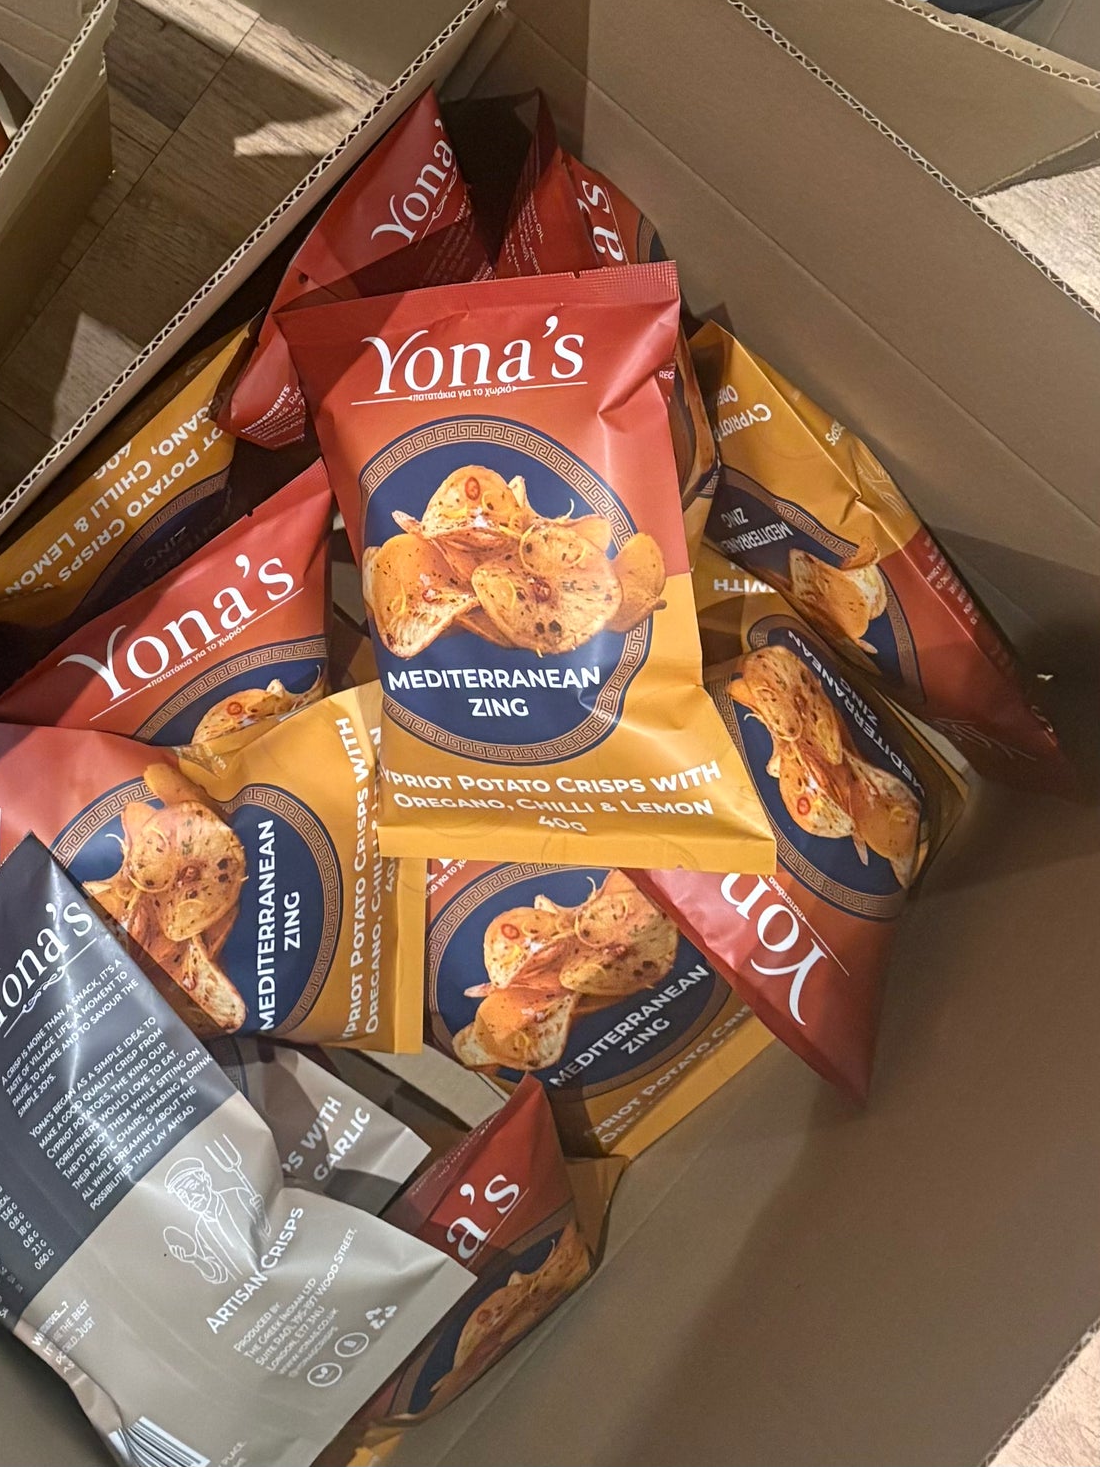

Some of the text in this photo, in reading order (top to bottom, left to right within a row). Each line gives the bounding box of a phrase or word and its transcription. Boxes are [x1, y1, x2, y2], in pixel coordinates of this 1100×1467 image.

[371, 119, 455, 243] Yona'
[363, 315, 584, 395] Yona's
[151, 407, 209, 456] GANO,
[90, 460, 152, 519] CHILLI
[115, 448, 199, 517] POTATO
[5, 532, 76, 594] LEMON
[48, 518, 125, 581] CRISPS
[74, 517, 89, 532] &
[59, 554, 294, 701] Yona's
[388, 665, 602, 693] MEDITERRANEAN
[468, 698, 529, 717] ZING
[381, 760, 722, 793] YPRIOT POTATO CRISPS WITH
[393, 793, 714, 815] OREGANO, CHILLI & LEMON
[336, 717, 369, 1037] YPRIOT POTATO CRISPS WITH
[257, 820, 275, 1030] MEDITERRANEAN
[284, 892, 300, 951] ZING
[365, 915, 382, 1033] OREGANO,
[6, 1076, 22, 1095] TASTE
[21, 1063, 29, 1076] OF
[29, 1036, 56, 1066] VILLAGE
[74, 1012, 82, 1022] A
[81, 980, 115, 1015] MOMENT
[115, 971, 127, 983] TO
[12, 979, 138, 1107] PAUSE, TO SHARE AND TO SAVOUR THE
[547, 957, 710, 1096] MEDITERRANEAN
[620, 1018, 670, 1054] ZING
[29, 1112, 54, 1138] YONA'S
[53, 1087, 76, 1114] BEGAN
[77, 1077, 87, 1091] AS
[88, 1072, 95, 1080] A
[94, 1045, 124, 1074] SIMPLE
[143, 1017, 155, 1028] TO
[39, 1028, 162, 1149] MAKE A GOOD QUALITY CRISP FROM
[46, 1042, 167, 1159] CYPRIOT POTATOES, THE KIND OUR
[62, 1048, 200, 1179] THEY'D ENJOY THEM WHILE SITTING ON
[590, 1093, 641, 1138] PRIOT
[72, 1054, 213, 1189] THEIR PLASTIC CHAIRS, SHARING A DRINK
[301, 1094, 342, 1151] WITH
[313, 1106, 372, 1183] GARLIC
[205, 1269, 269, 1336] ARTISAN
[262, 1205, 305, 1273] CRISPS
[315, 1264, 339, 1295] WOOD
